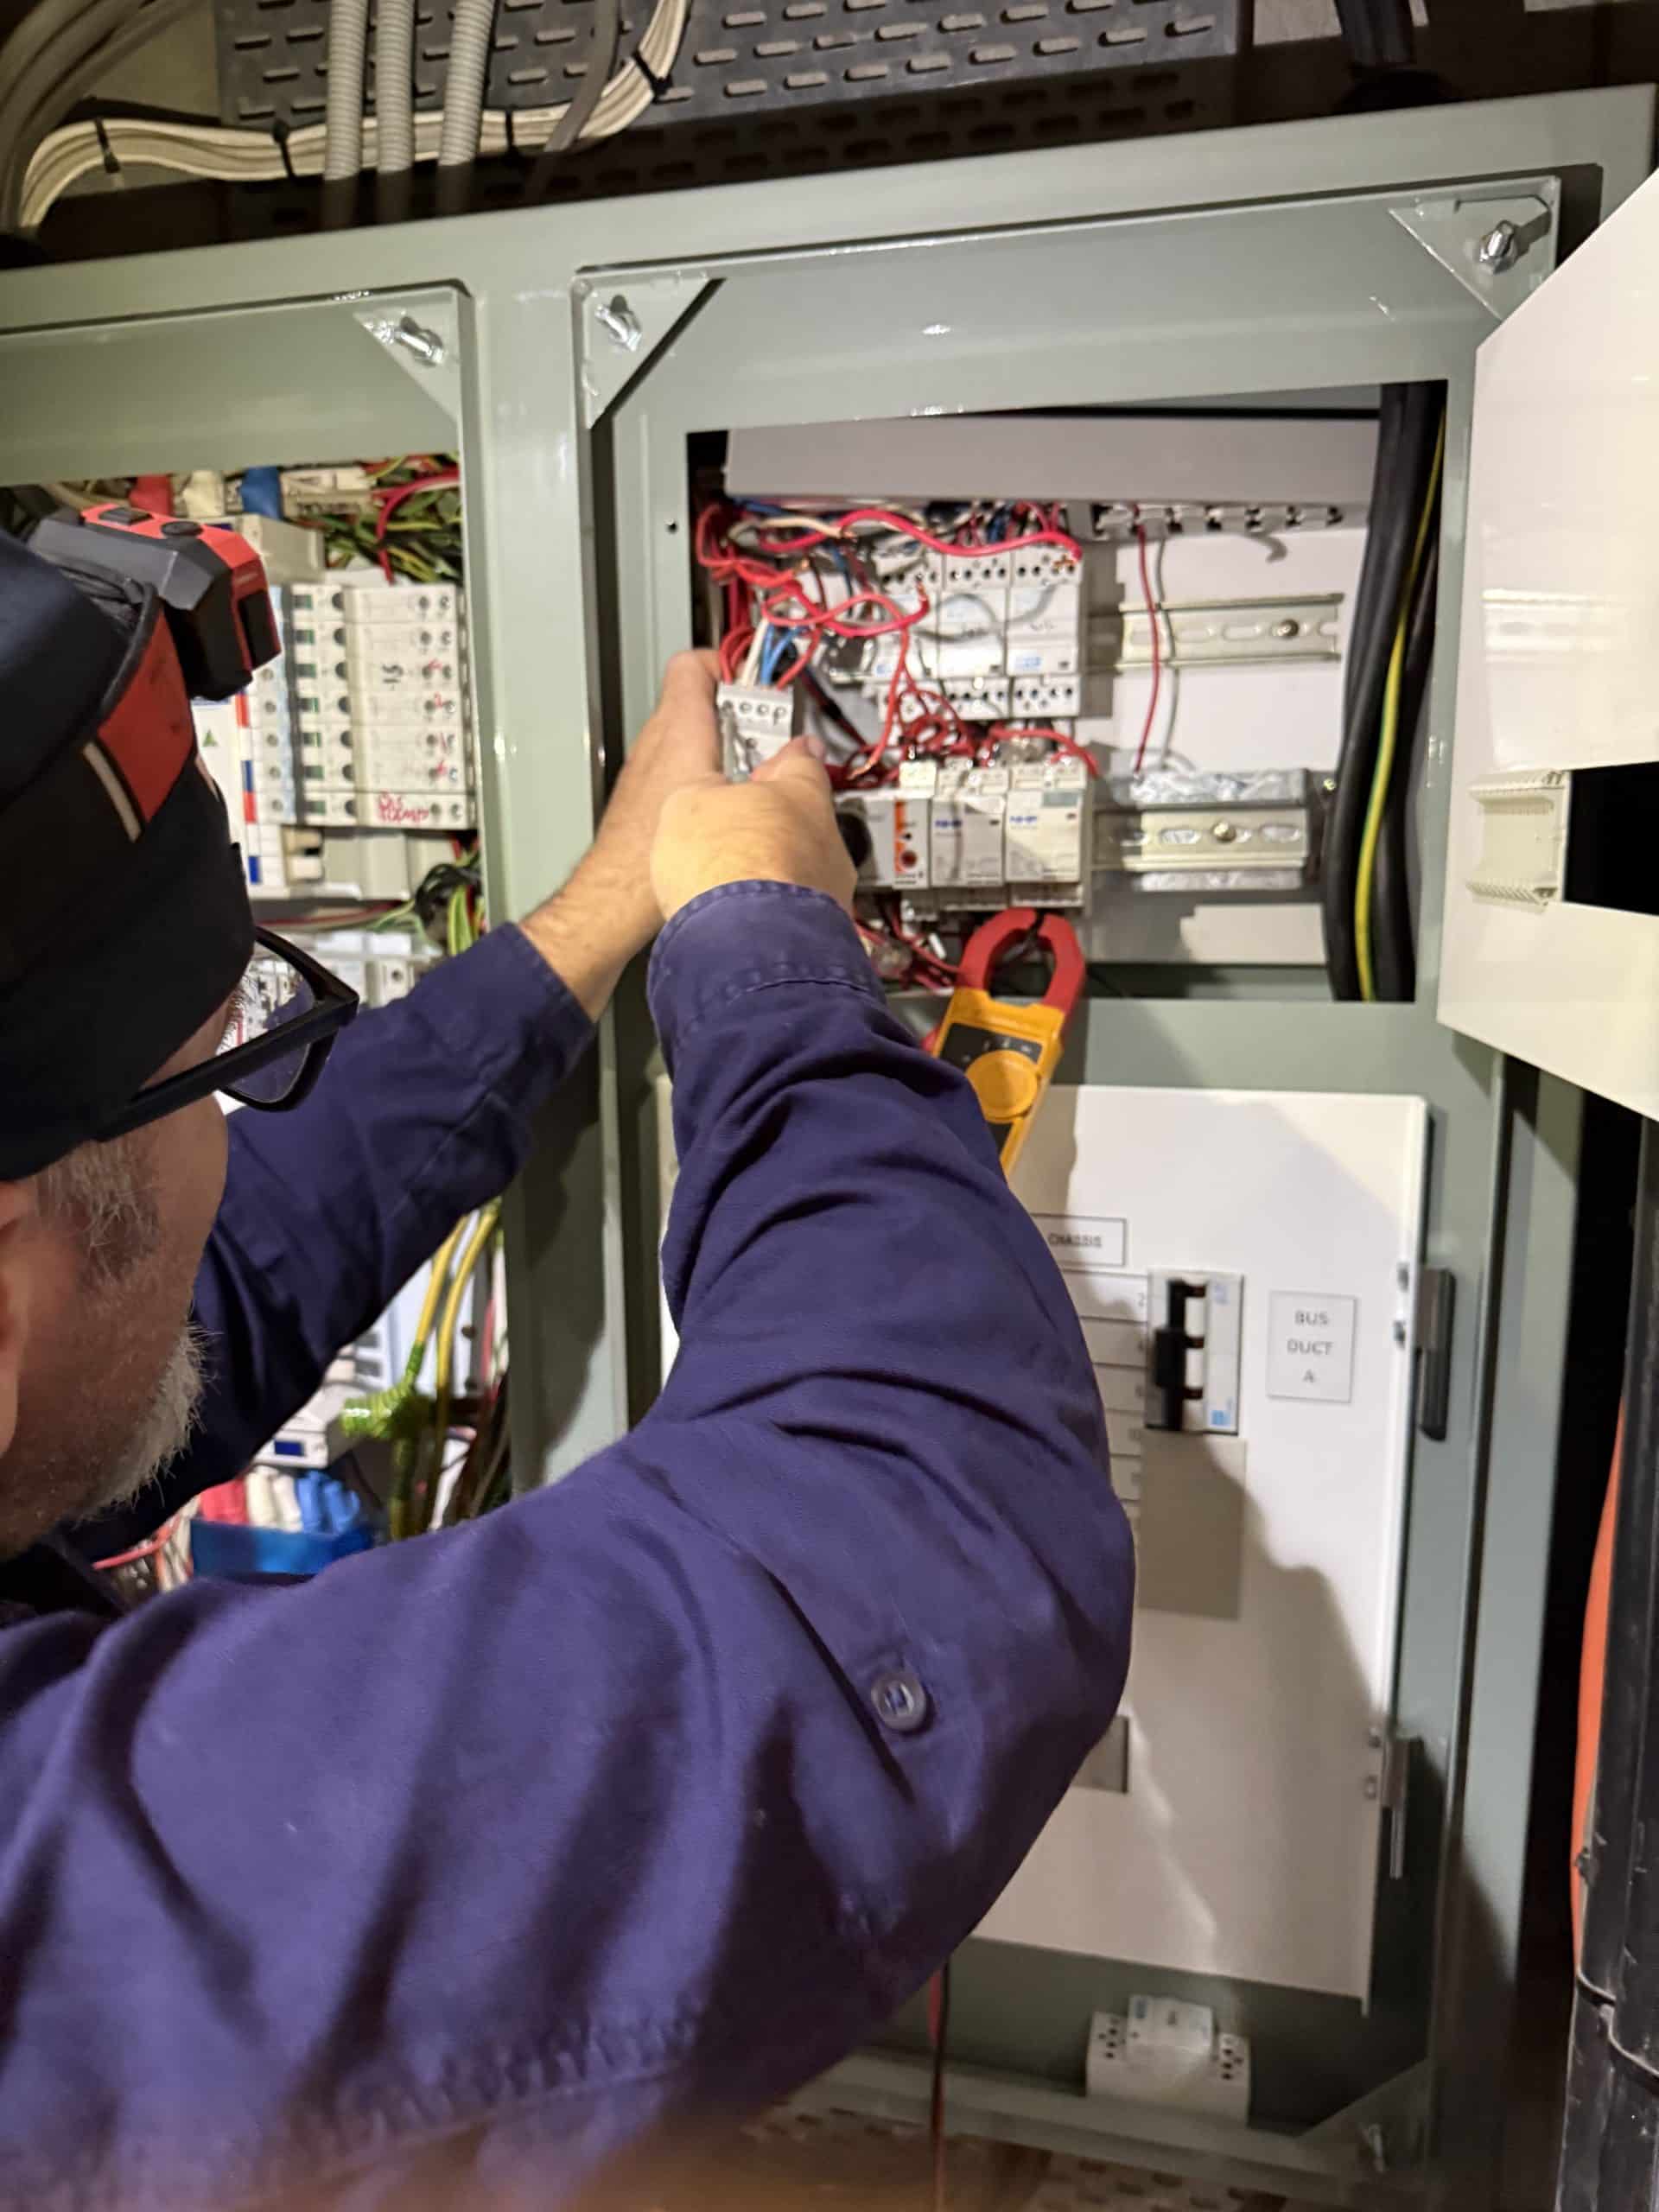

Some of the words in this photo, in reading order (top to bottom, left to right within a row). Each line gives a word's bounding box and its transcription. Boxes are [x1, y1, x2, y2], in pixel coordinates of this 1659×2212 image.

[1048, 1232, 1103, 1249] CHASSIS
[1294, 1310, 1330, 1326] BUS
[1287, 1338, 1333, 1356] DUCT
[1302, 1369, 1316, 1384] A
